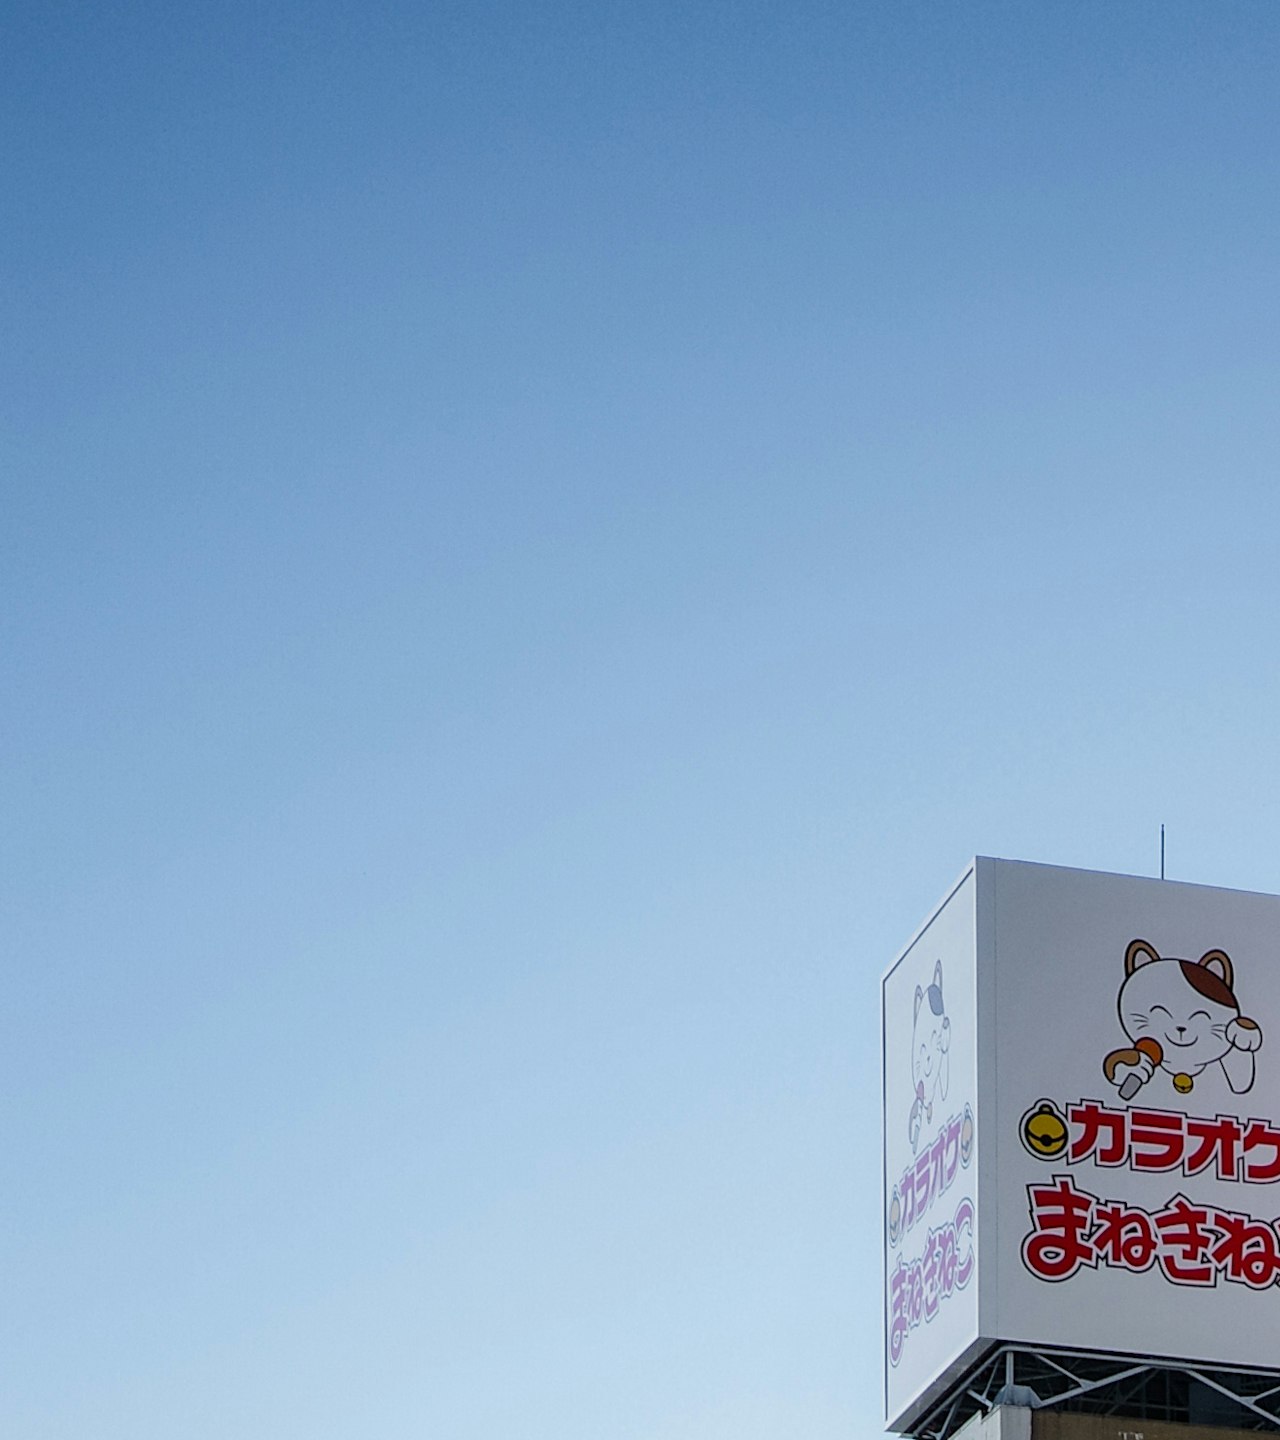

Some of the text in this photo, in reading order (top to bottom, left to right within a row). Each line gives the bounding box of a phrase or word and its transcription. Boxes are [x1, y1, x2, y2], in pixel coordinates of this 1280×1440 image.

[901, 1118, 962, 1232] カラオケ
[891, 1200, 975, 1364] まねきねこ
